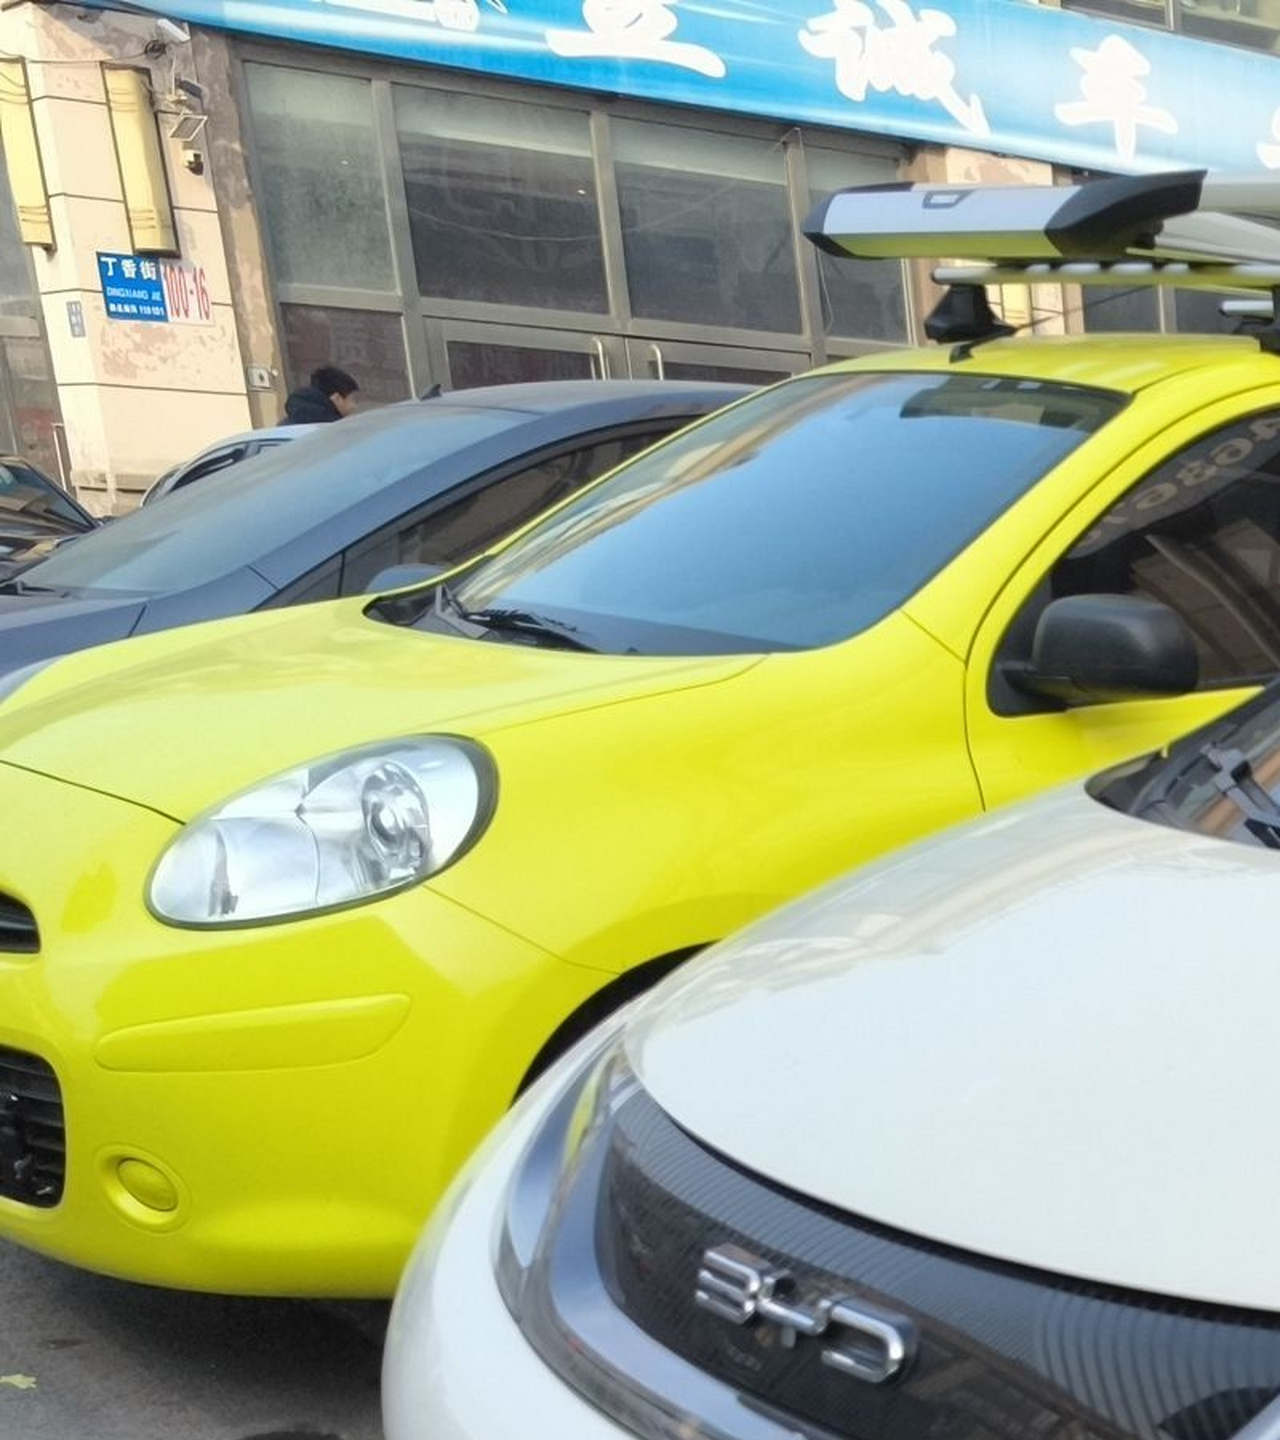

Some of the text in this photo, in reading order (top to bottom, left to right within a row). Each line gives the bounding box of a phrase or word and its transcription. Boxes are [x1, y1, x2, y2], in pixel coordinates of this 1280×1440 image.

[100, 256, 156, 281] 丁香街
[696, 1243, 908, 1383] BYD
